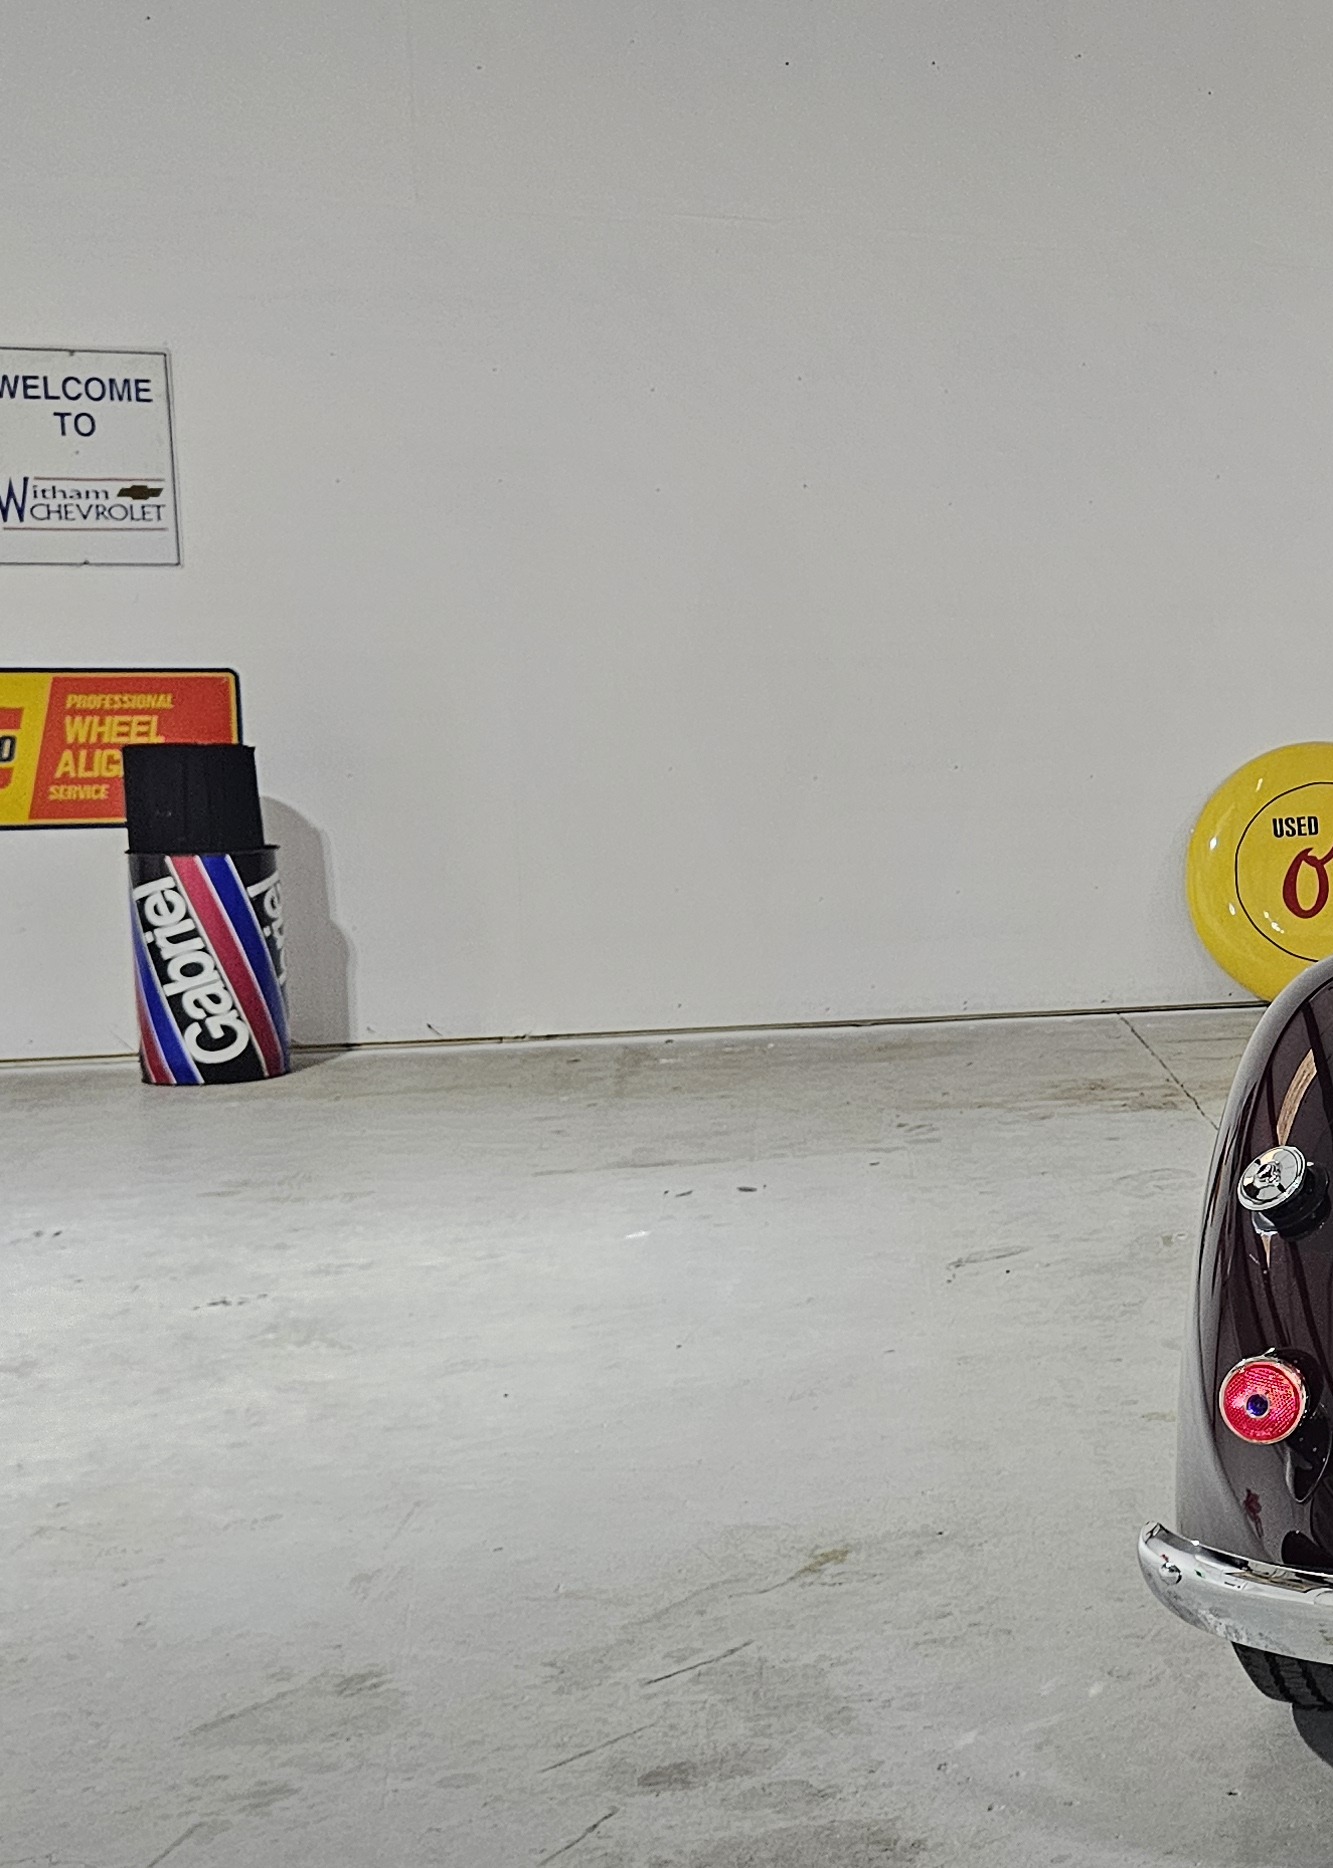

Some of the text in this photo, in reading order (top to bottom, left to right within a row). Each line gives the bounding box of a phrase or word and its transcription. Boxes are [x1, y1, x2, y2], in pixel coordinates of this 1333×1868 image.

[0, 374, 153, 403] WELCOME
[53, 411, 97, 437] TO
[0, 476, 109, 523] Witham
[30, 502, 166, 521] CHEVROLET
[65, 693, 175, 710] PROFESSIONAL
[65, 714, 165, 744] WHEEL
[54, 749, 124, 779] ALIG
[48, 784, 110, 801] SERVICE
[1272, 815, 1319, 839] USED
[133, 875, 251, 1065] Gabriel
